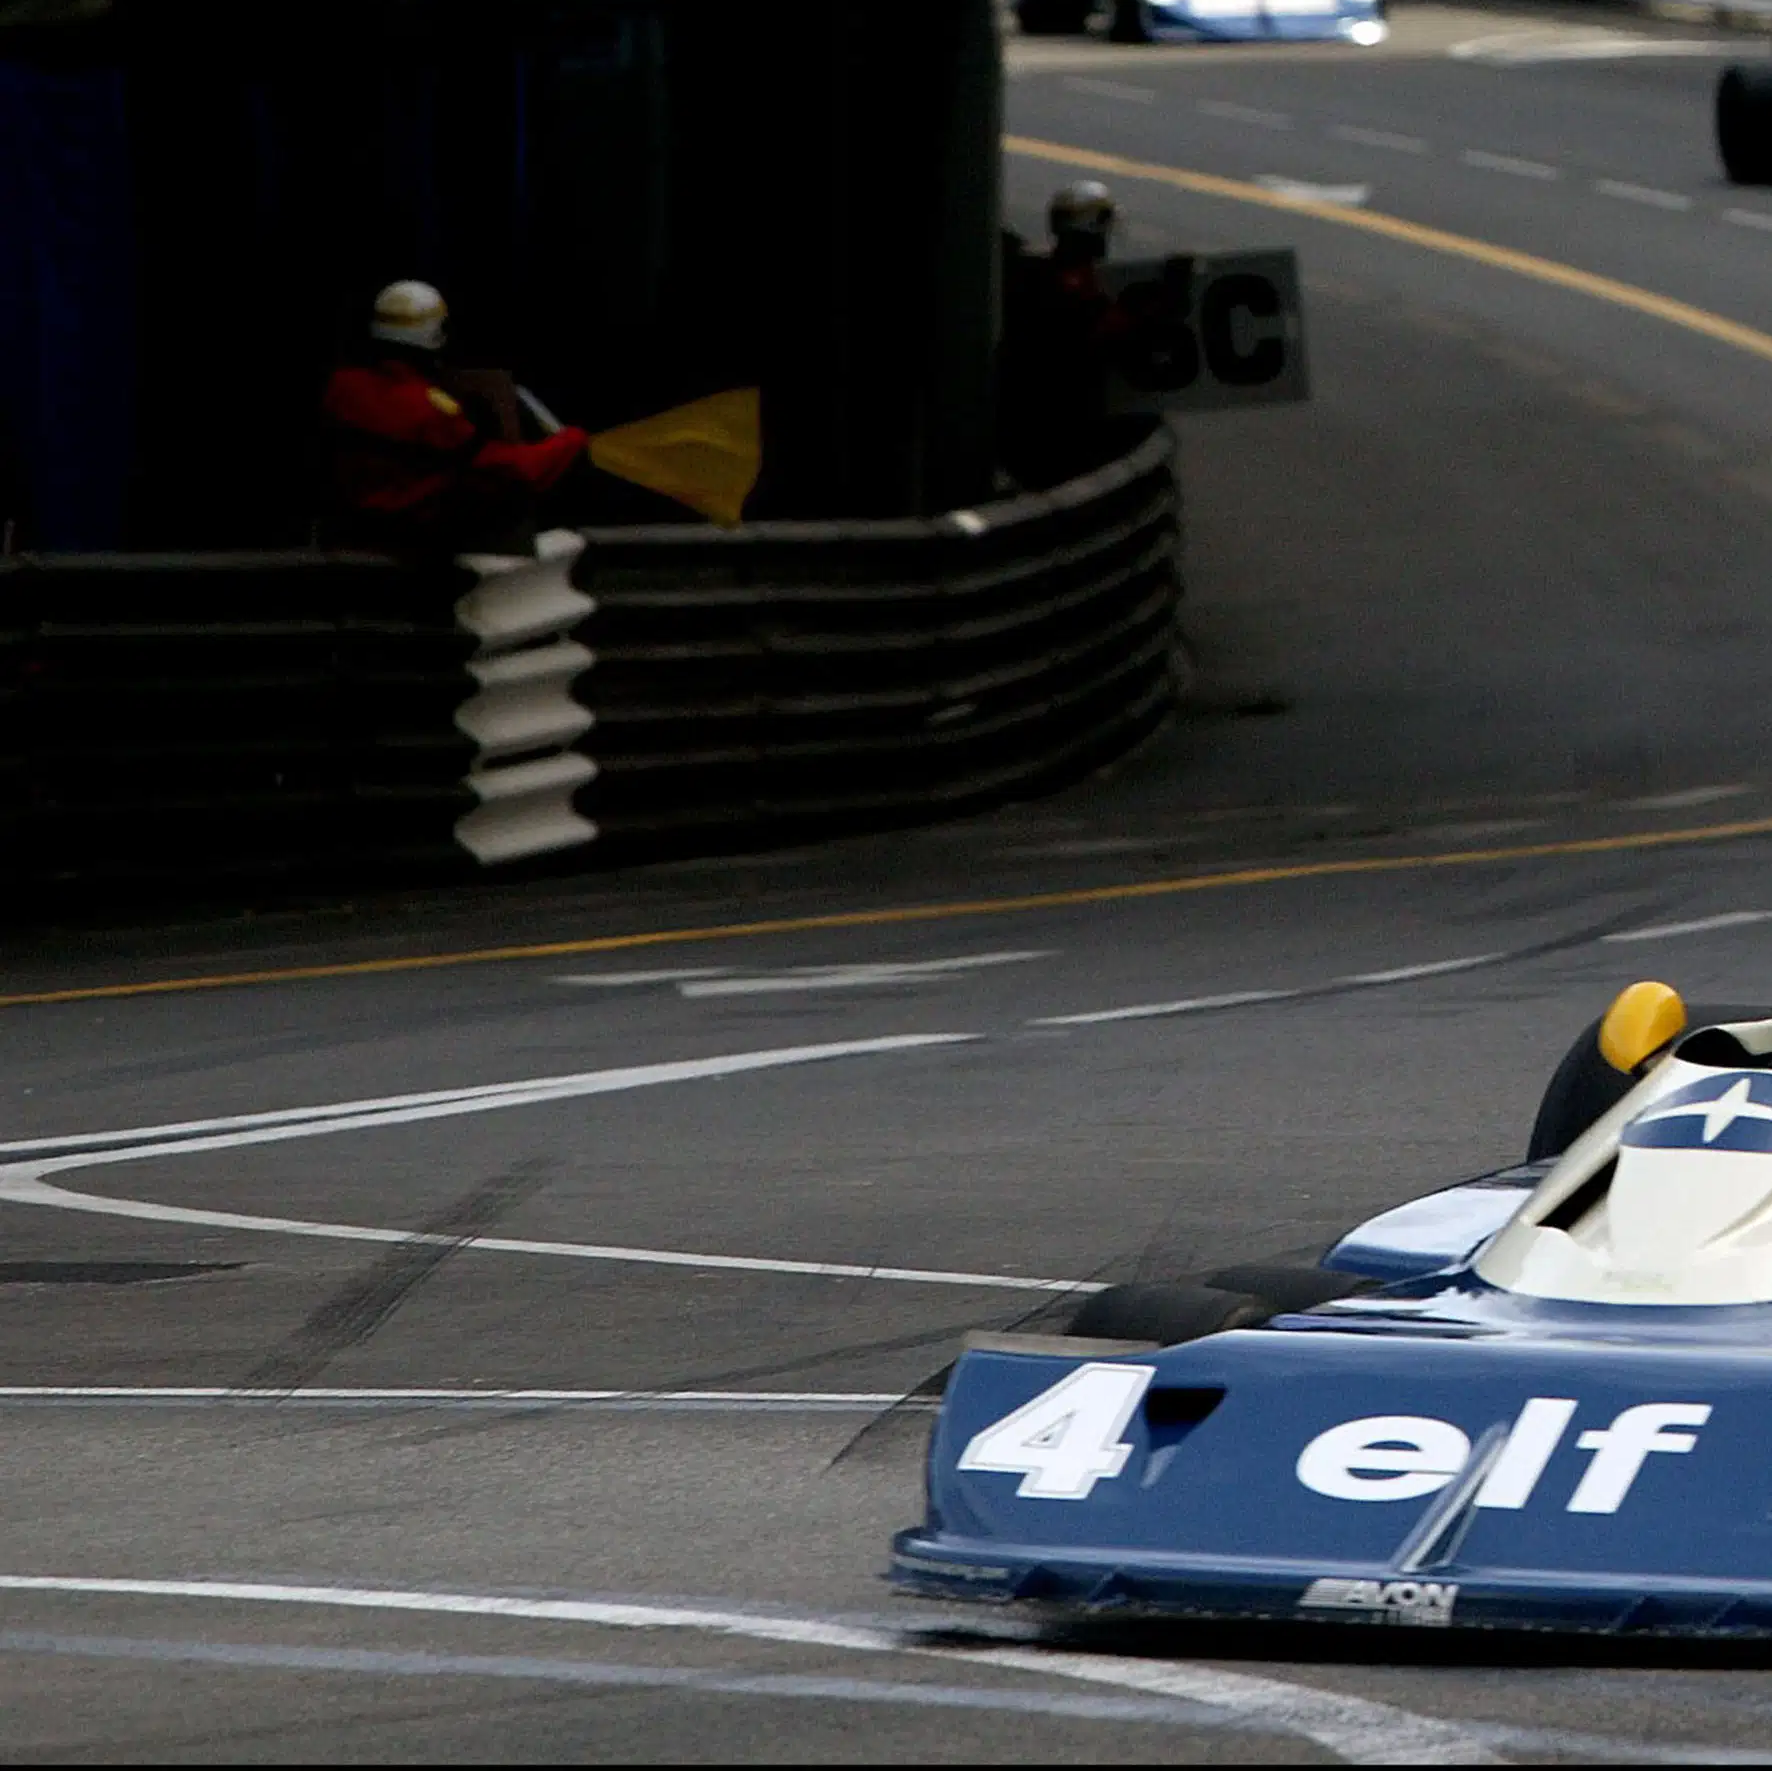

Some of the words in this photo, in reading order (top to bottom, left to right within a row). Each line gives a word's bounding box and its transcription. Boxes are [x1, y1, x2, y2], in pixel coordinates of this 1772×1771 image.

[957, 1360, 1158, 1502] 4
[1294, 1396, 1713, 1514] elf
[1344, 1579, 1460, 1609] AVON
